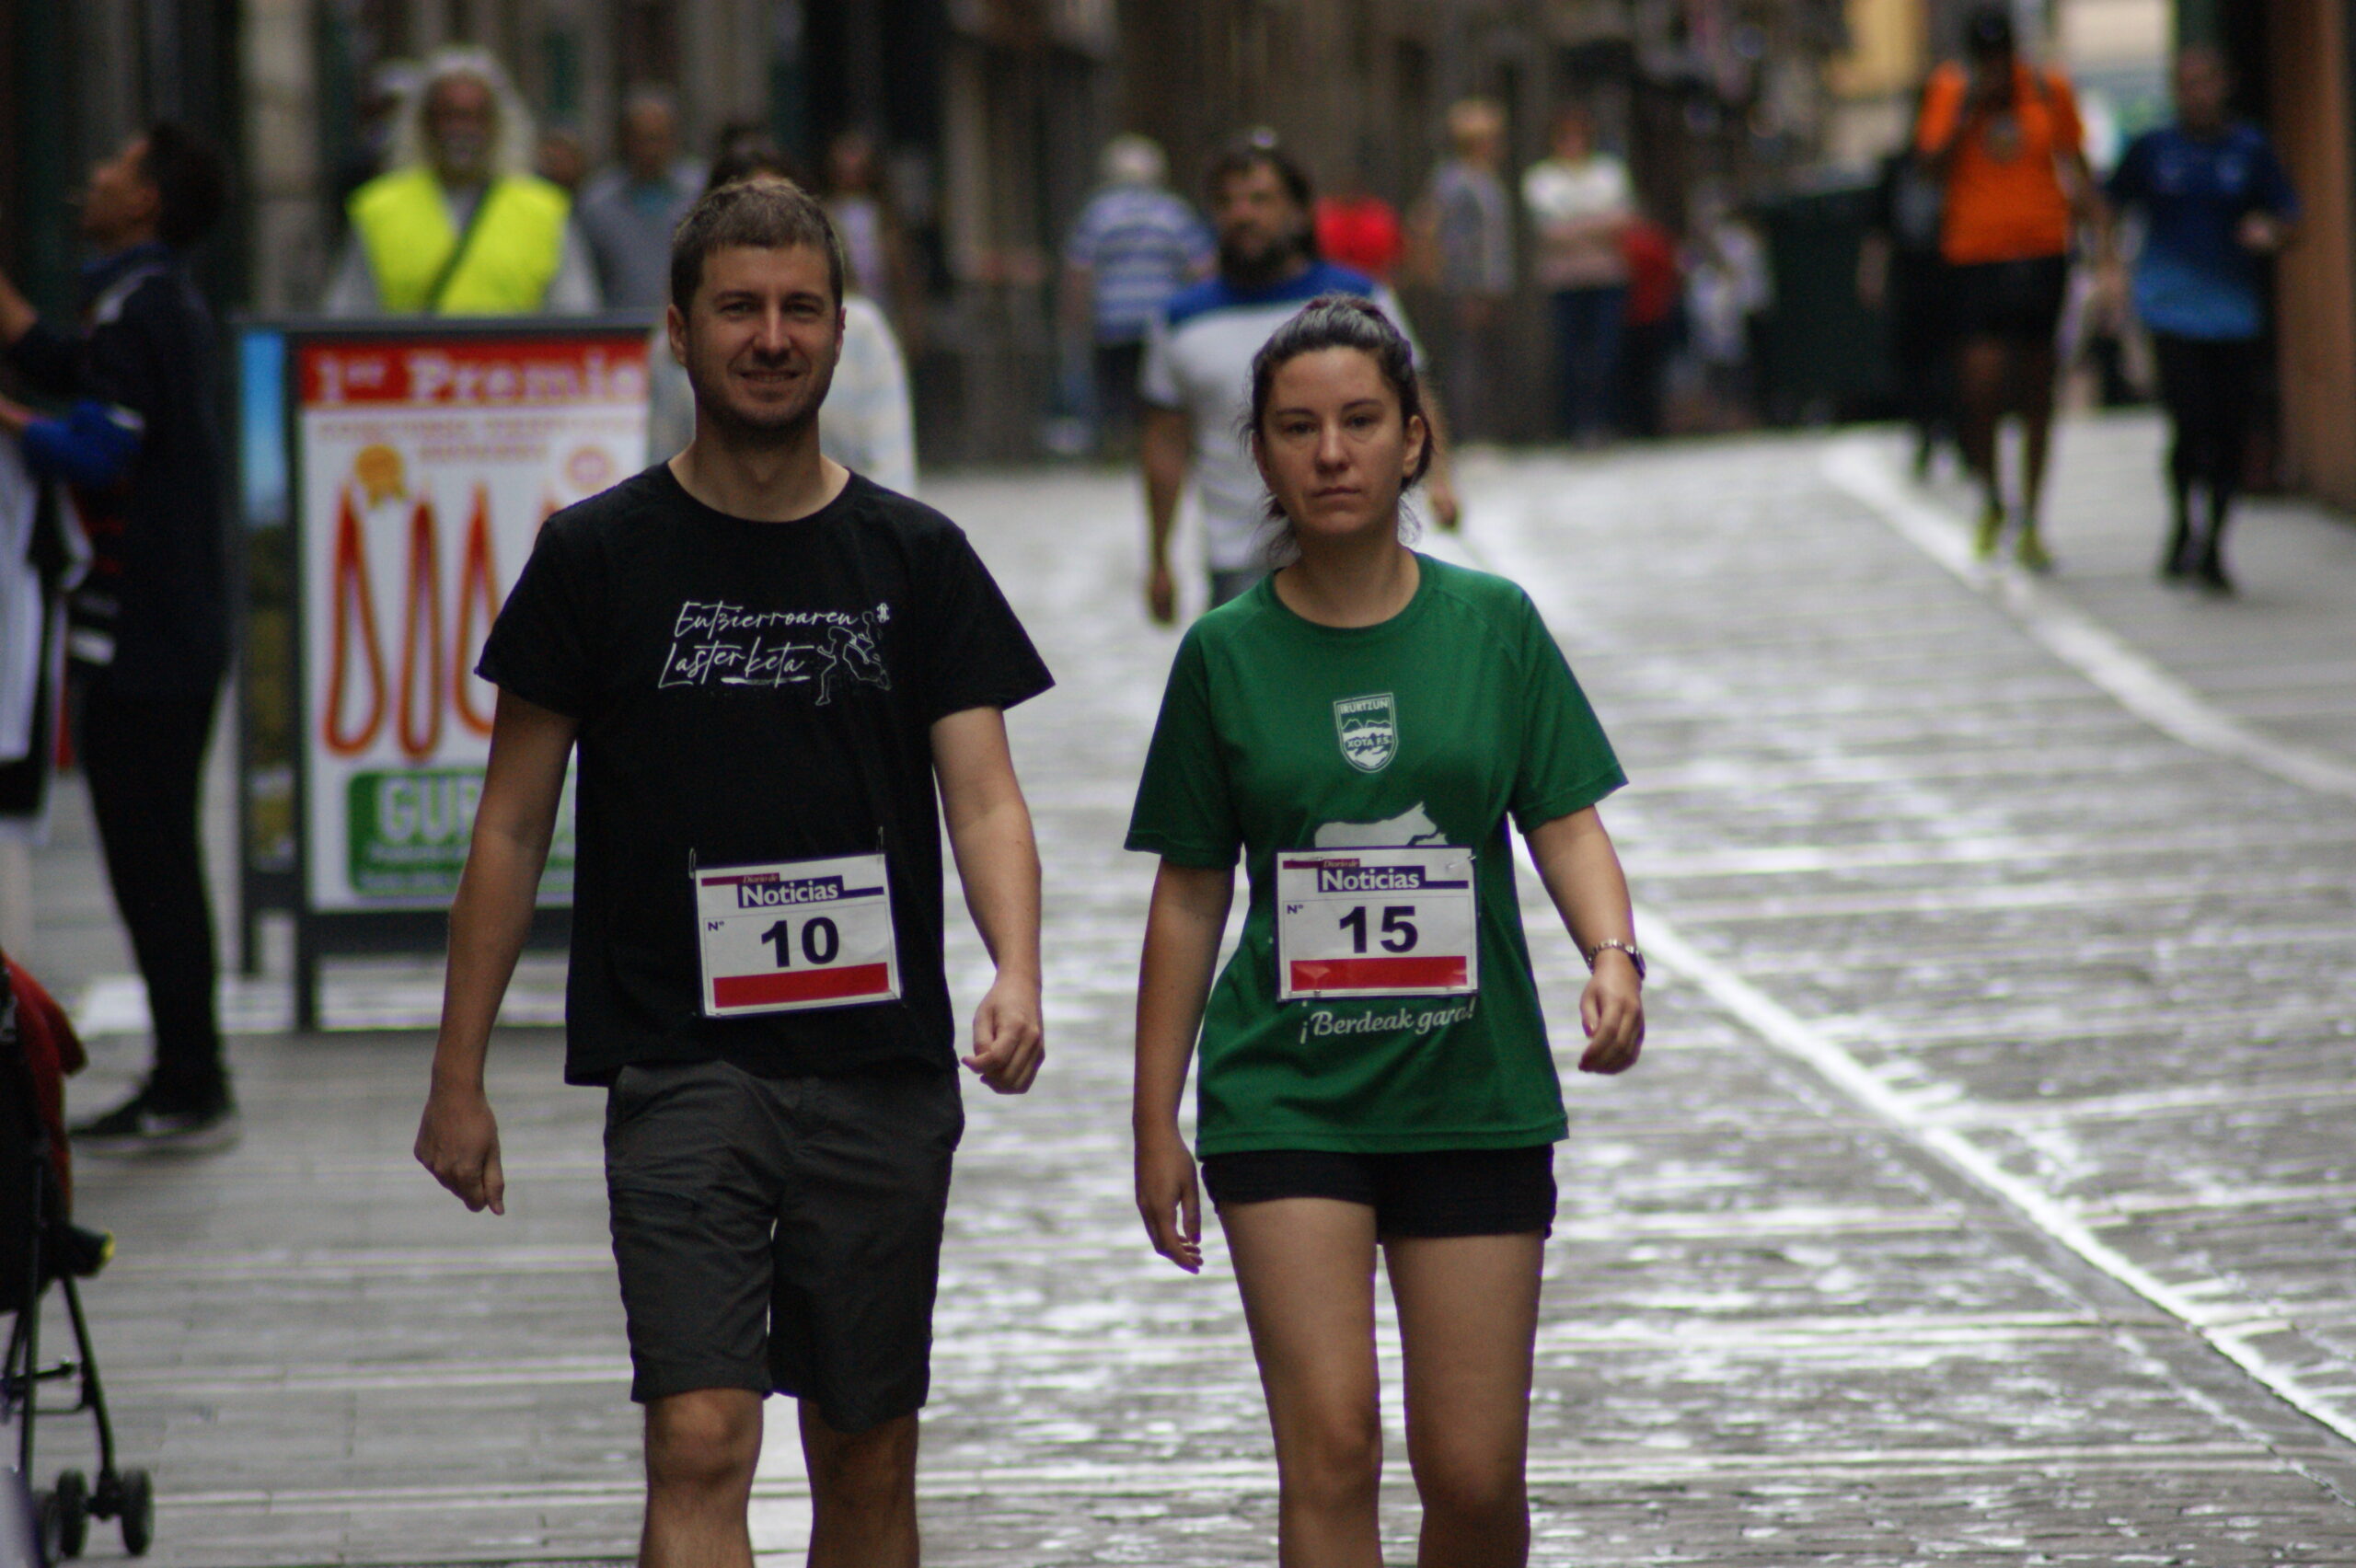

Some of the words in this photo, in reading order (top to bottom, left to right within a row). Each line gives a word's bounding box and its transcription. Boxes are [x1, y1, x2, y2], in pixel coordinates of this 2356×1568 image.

[408, 346, 648, 401] Premio
[658, 637, 814, 687] Lasterketa
[742, 881, 838, 906] Noticias
[1322, 869, 1420, 891] Noticias
[761, 917, 839, 968] 10
[1339, 905, 1418, 953] 15
